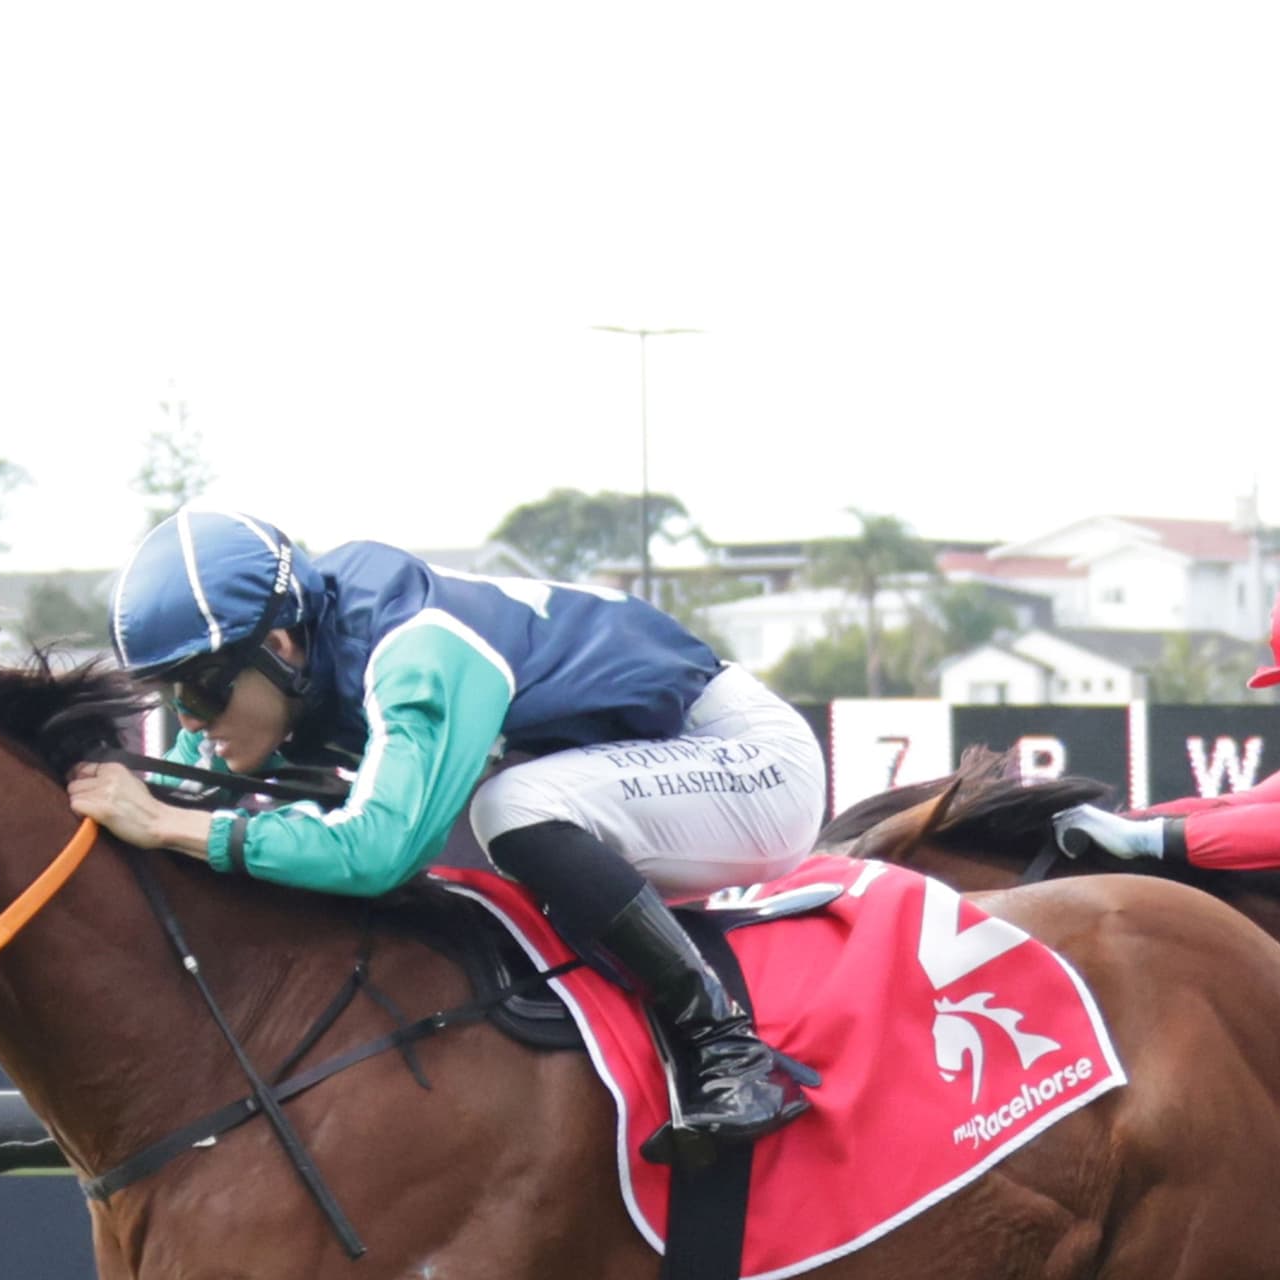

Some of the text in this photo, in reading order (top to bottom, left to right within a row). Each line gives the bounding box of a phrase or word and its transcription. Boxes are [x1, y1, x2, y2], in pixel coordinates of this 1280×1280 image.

[620, 777, 652, 801] M.
[1186, 736, 1263, 798] W
[953, 1056, 1094, 1150] myRacehorse
